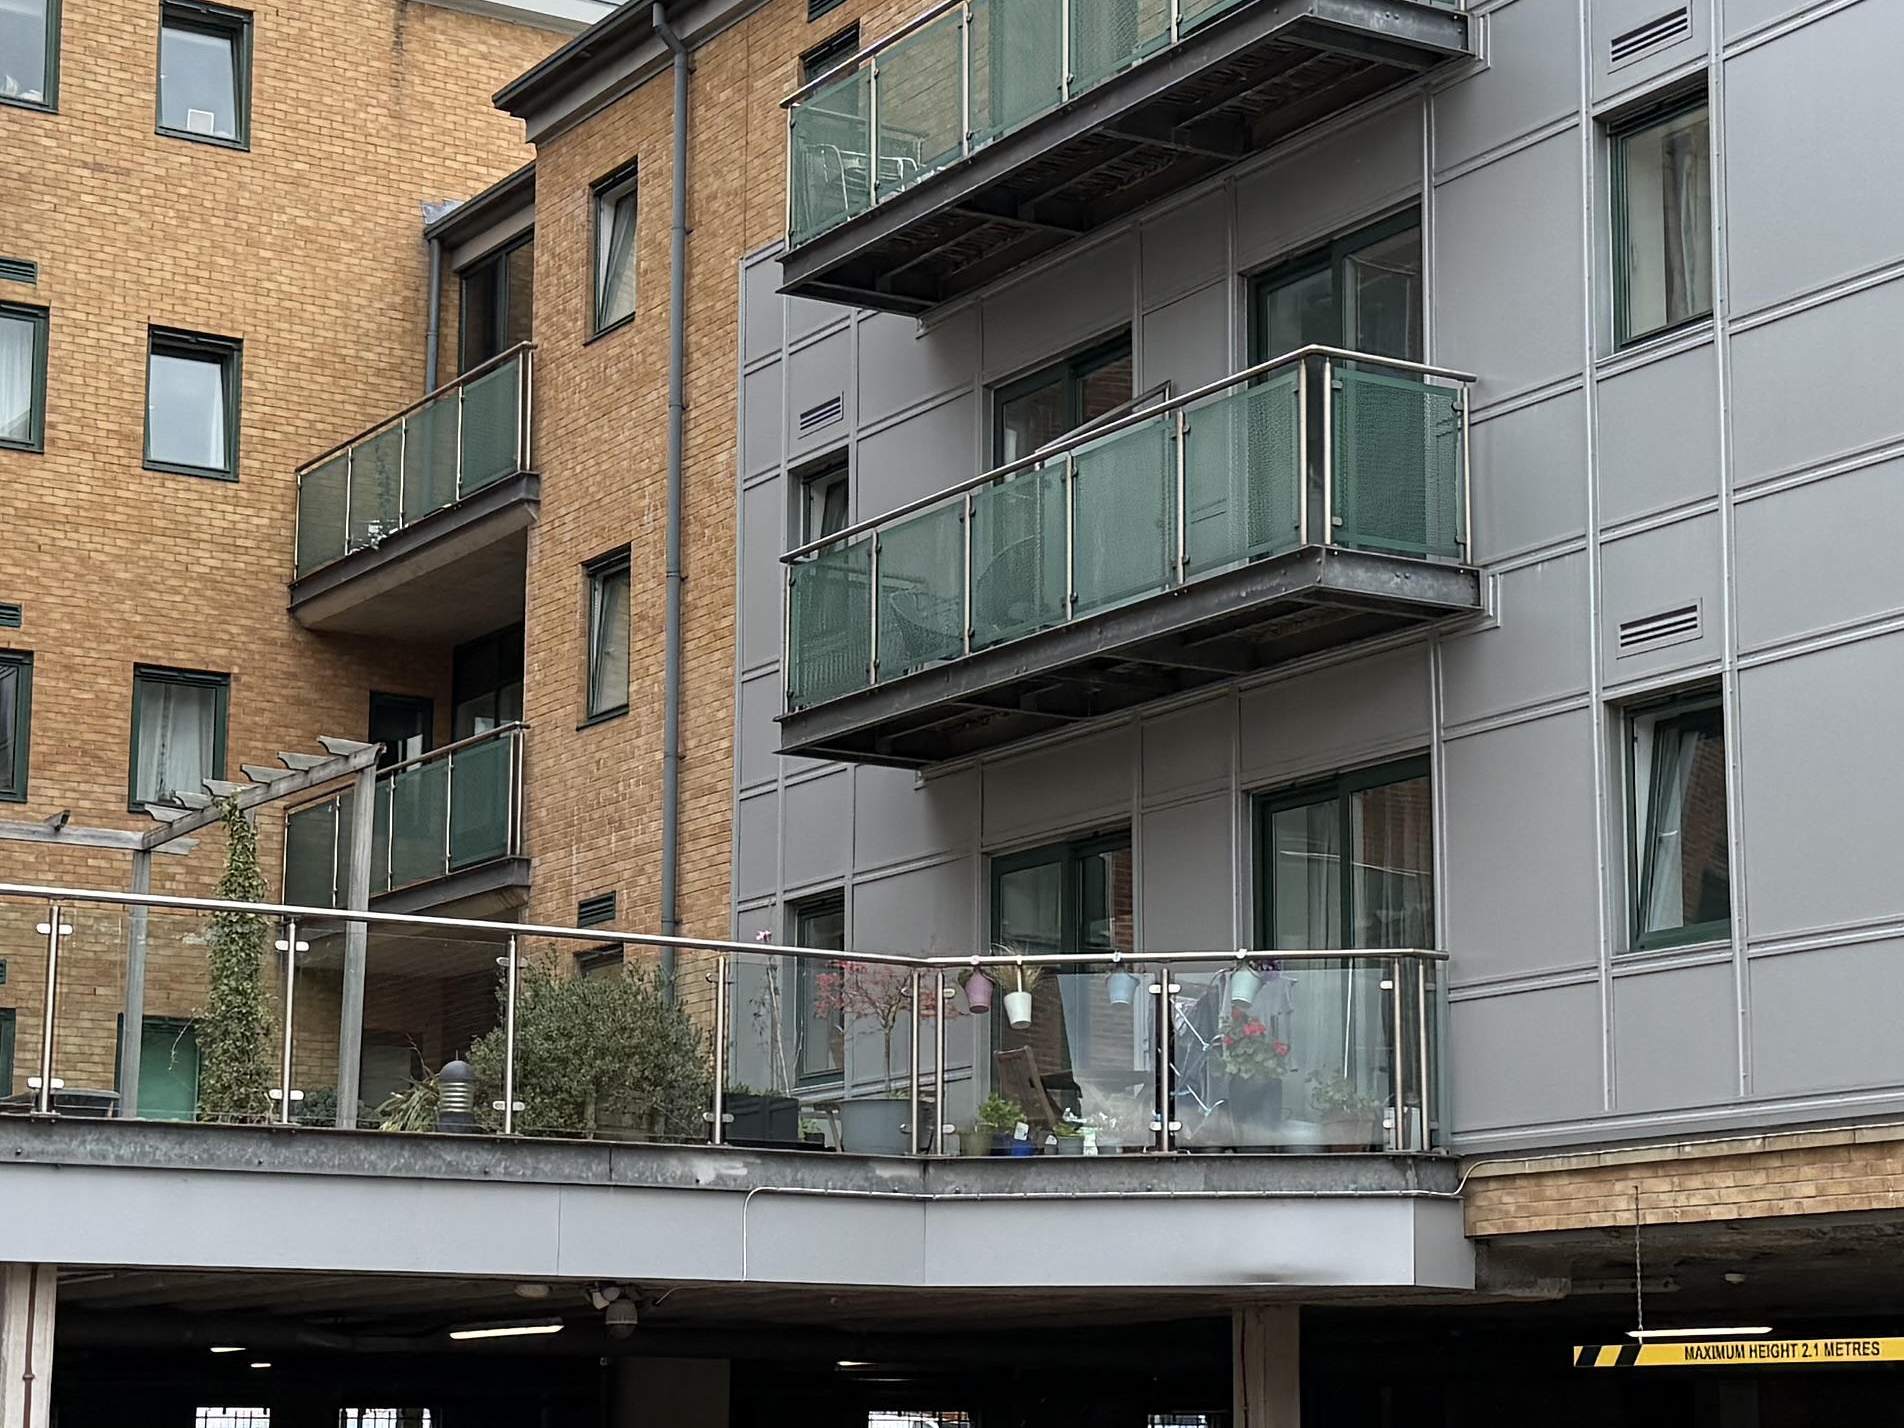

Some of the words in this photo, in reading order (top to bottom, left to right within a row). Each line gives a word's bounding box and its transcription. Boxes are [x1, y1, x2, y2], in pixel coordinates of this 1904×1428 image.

[1684, 1344, 1746, 1360] MAXIMUM
[1749, 1343, 1798, 1359] HEIGHT
[1802, 1343, 1819, 1357] 2.1
[1824, 1341, 1880, 1357] METRES
